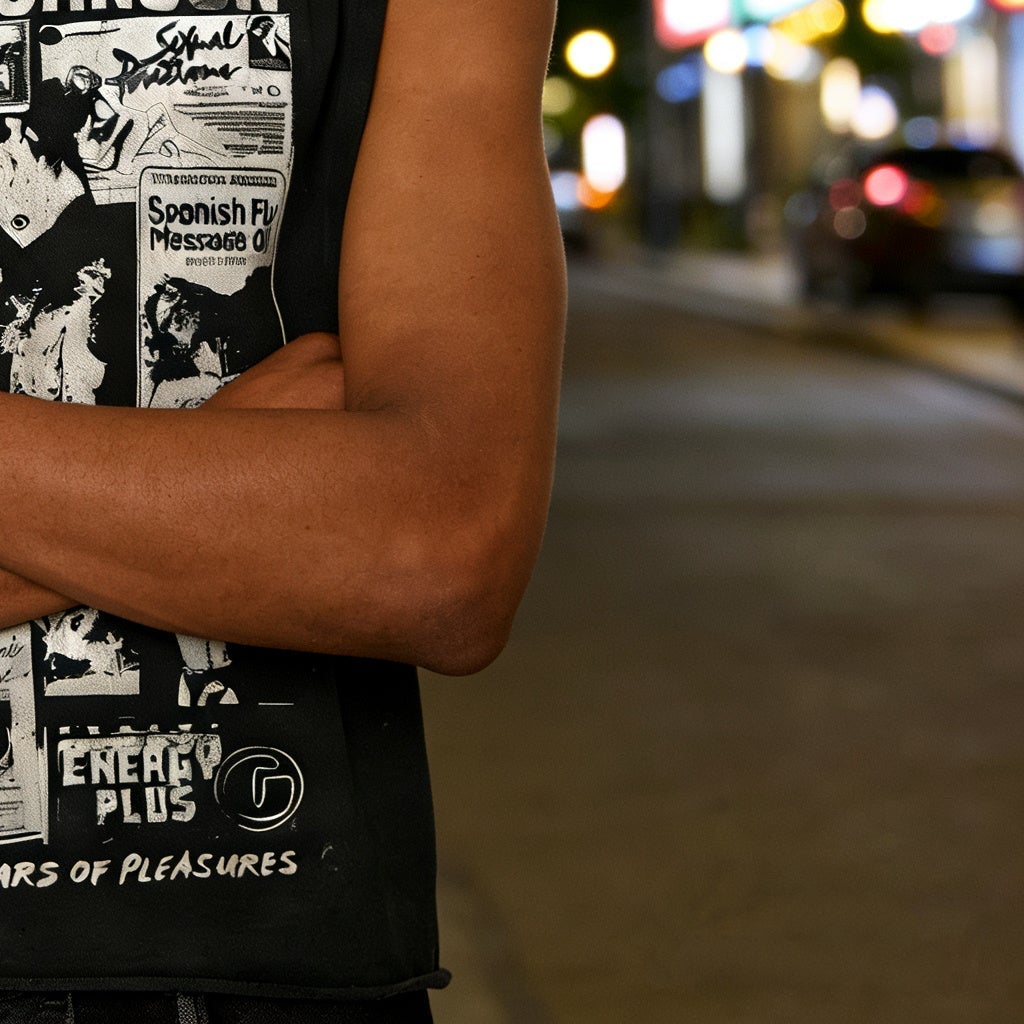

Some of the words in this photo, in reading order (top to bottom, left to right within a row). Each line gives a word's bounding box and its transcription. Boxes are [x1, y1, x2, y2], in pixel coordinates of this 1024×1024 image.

[95, 785, 196, 826] PLUS
[69, 859, 112, 886] OF
[118, 849, 298, 886] PLEASURES
